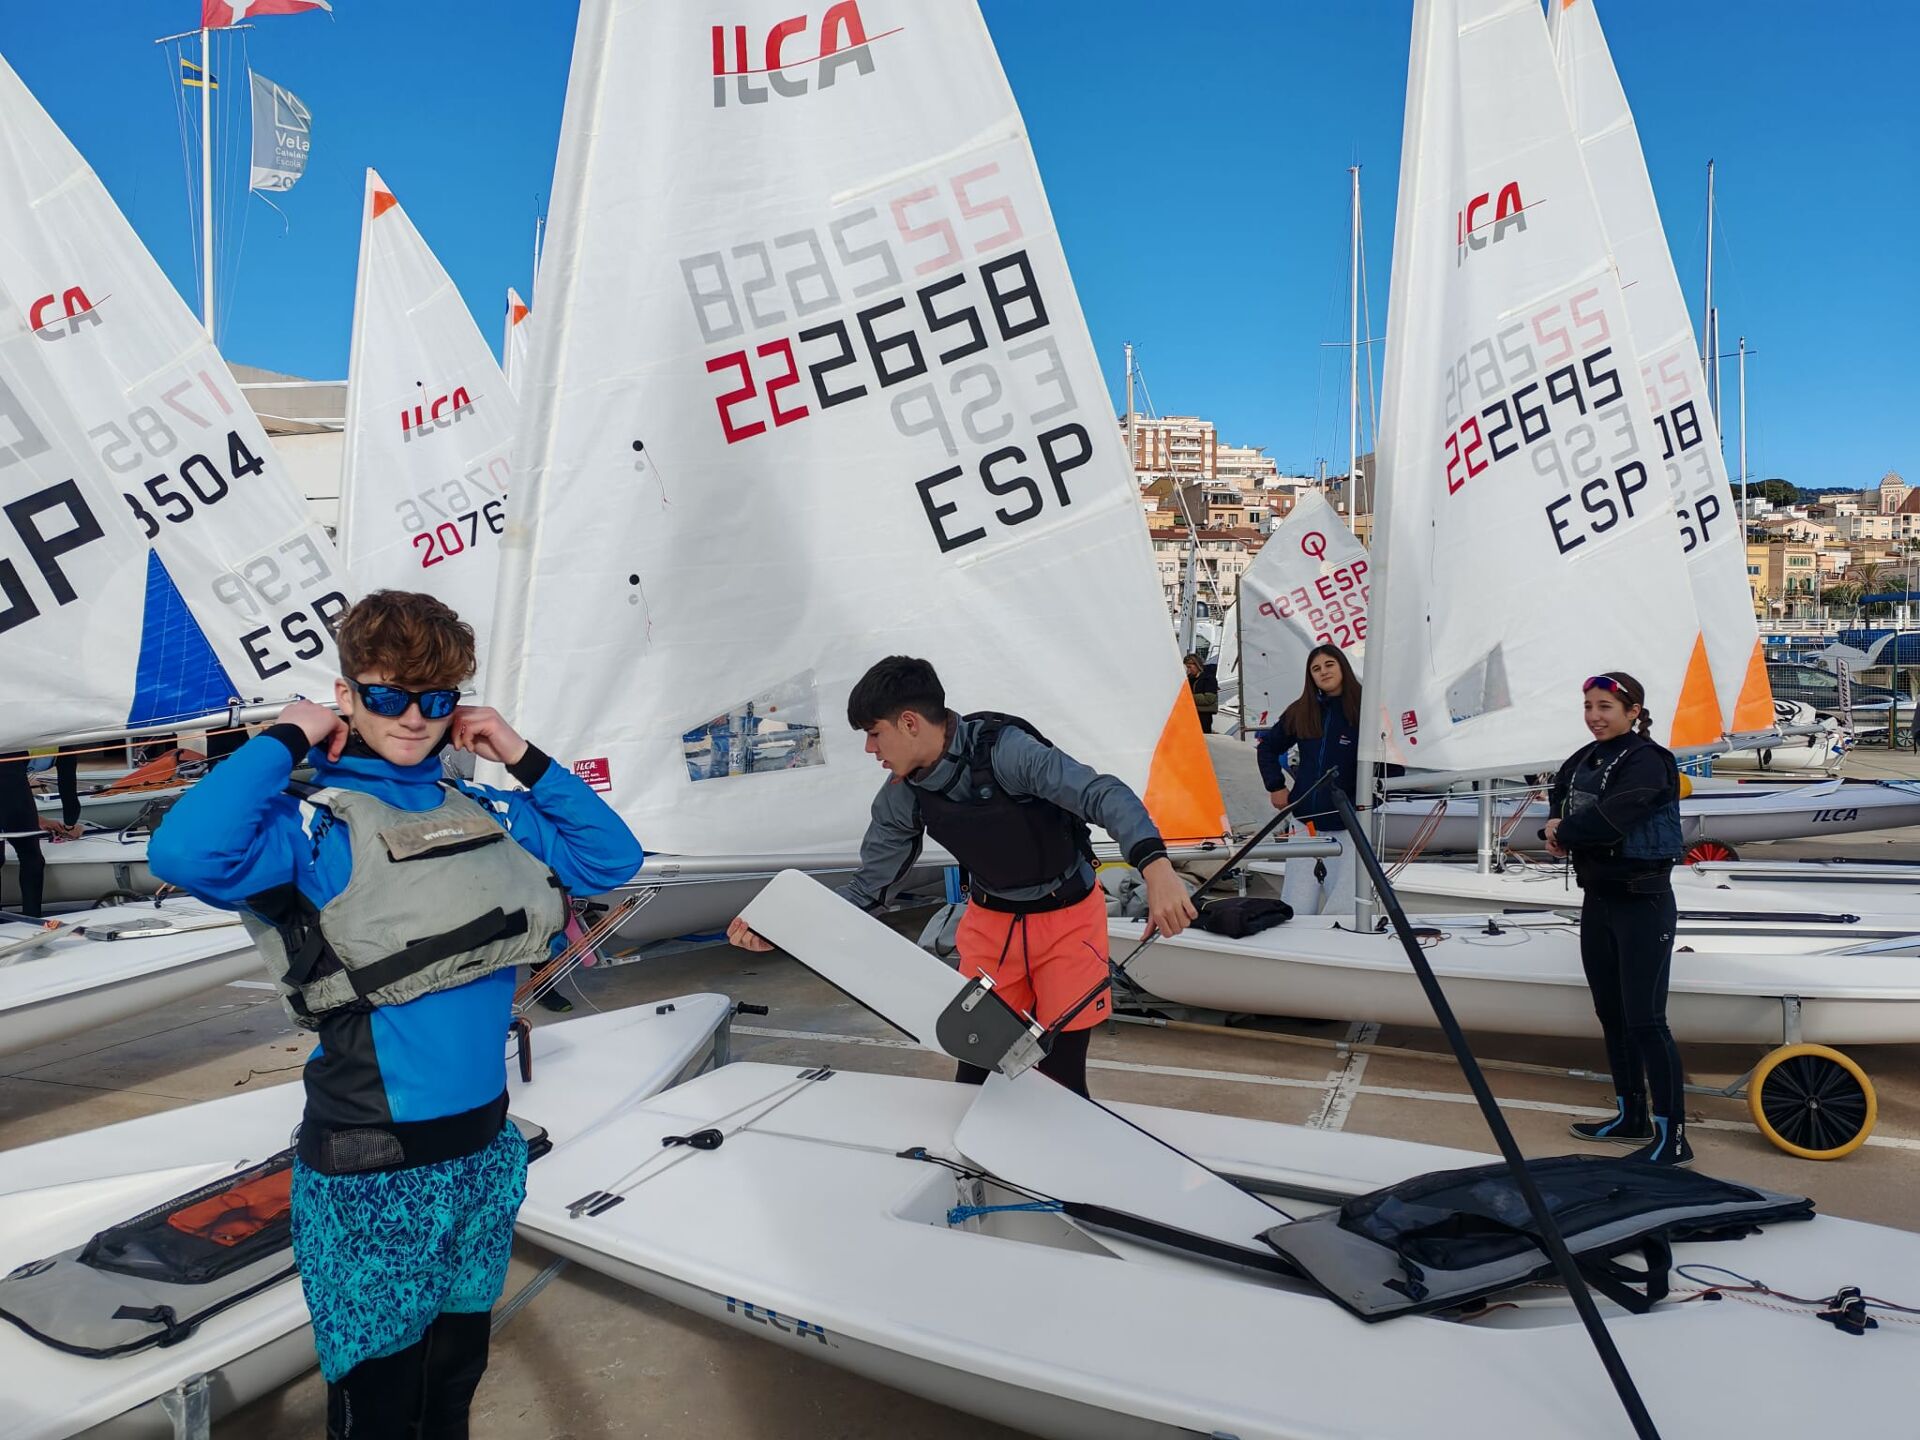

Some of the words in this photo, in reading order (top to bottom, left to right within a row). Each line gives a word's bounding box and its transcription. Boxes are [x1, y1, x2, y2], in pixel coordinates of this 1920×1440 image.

[712, 0, 875, 108] ILCA
[275, 130, 310, 152] Vela
[705, 249, 1050, 445] 222658
[401, 386, 475, 443] ILCA
[1444, 346, 1623, 496] 222695
[915, 422, 1093, 553] ESP
[1545, 460, 1647, 555] ESP
[413, 494, 507, 568] 2076
[1315, 560, 1368, 601] ESP
[239, 591, 353, 681] ESP
[576, 761, 595, 771] ILCA
[1812, 808, 1858, 822] ILCA
